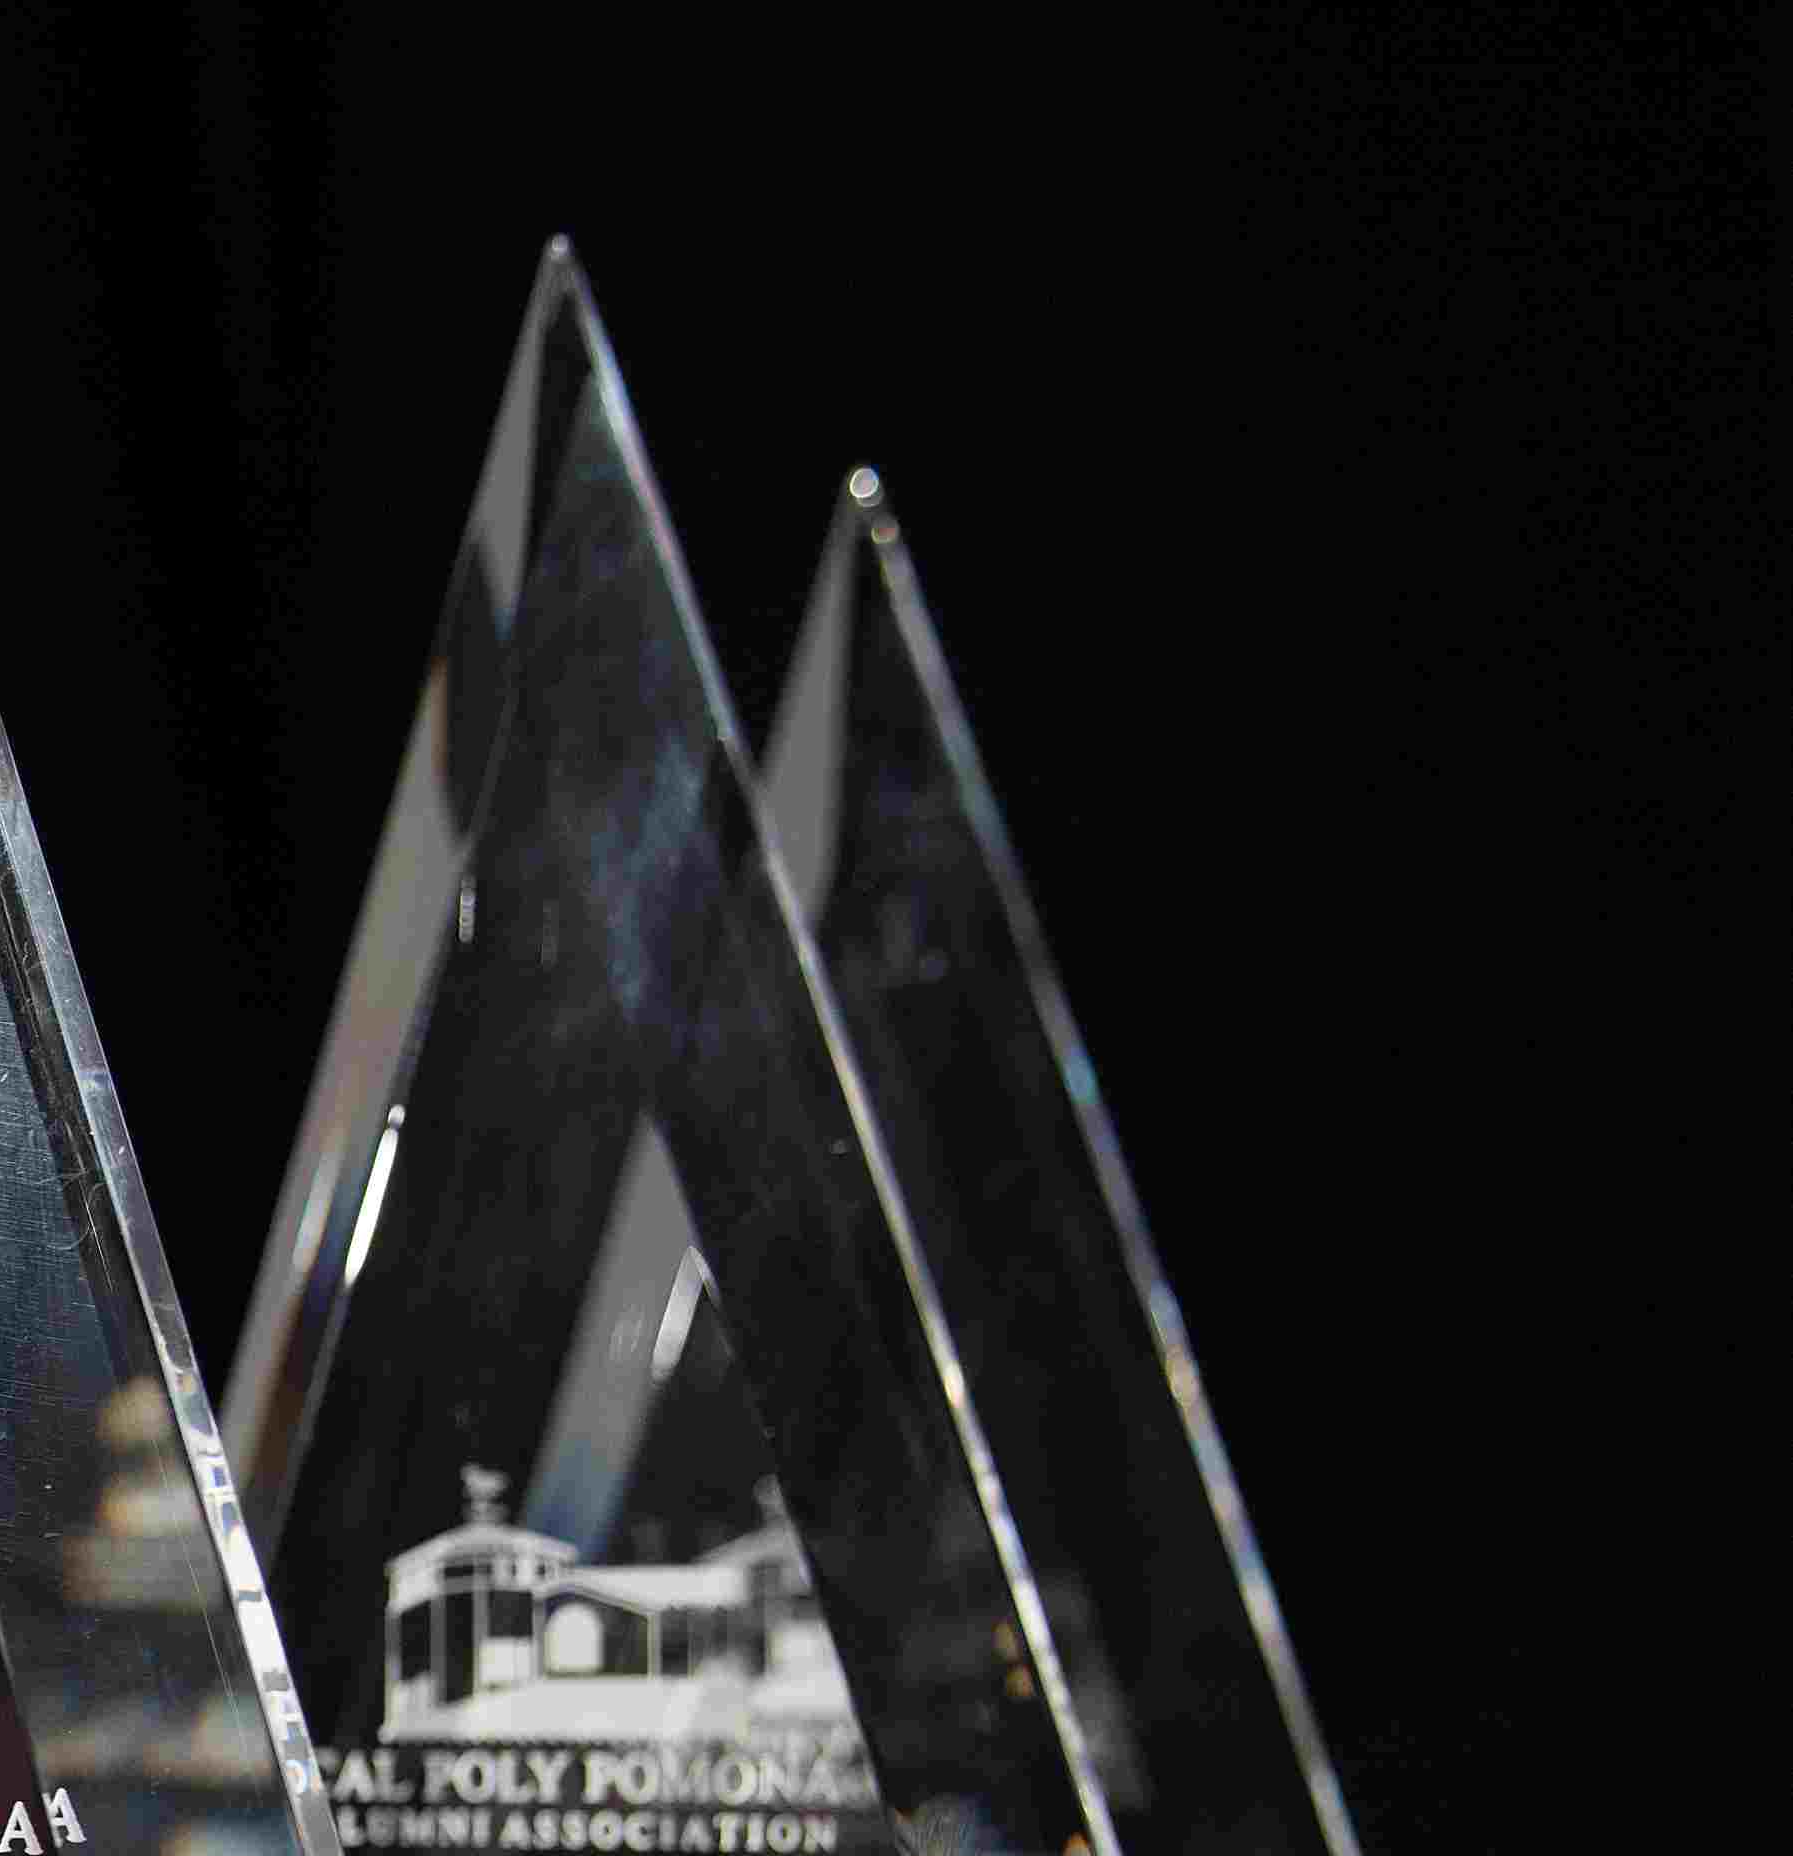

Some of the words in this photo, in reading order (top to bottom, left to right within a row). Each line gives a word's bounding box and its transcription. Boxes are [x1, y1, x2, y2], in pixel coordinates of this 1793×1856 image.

[423, 1748, 573, 1805] POLY
[583, 1750, 840, 1808] POMONA
[336, 1806, 491, 1848] LUMNI
[500, 1809, 838, 1855] ASSOCIATION
